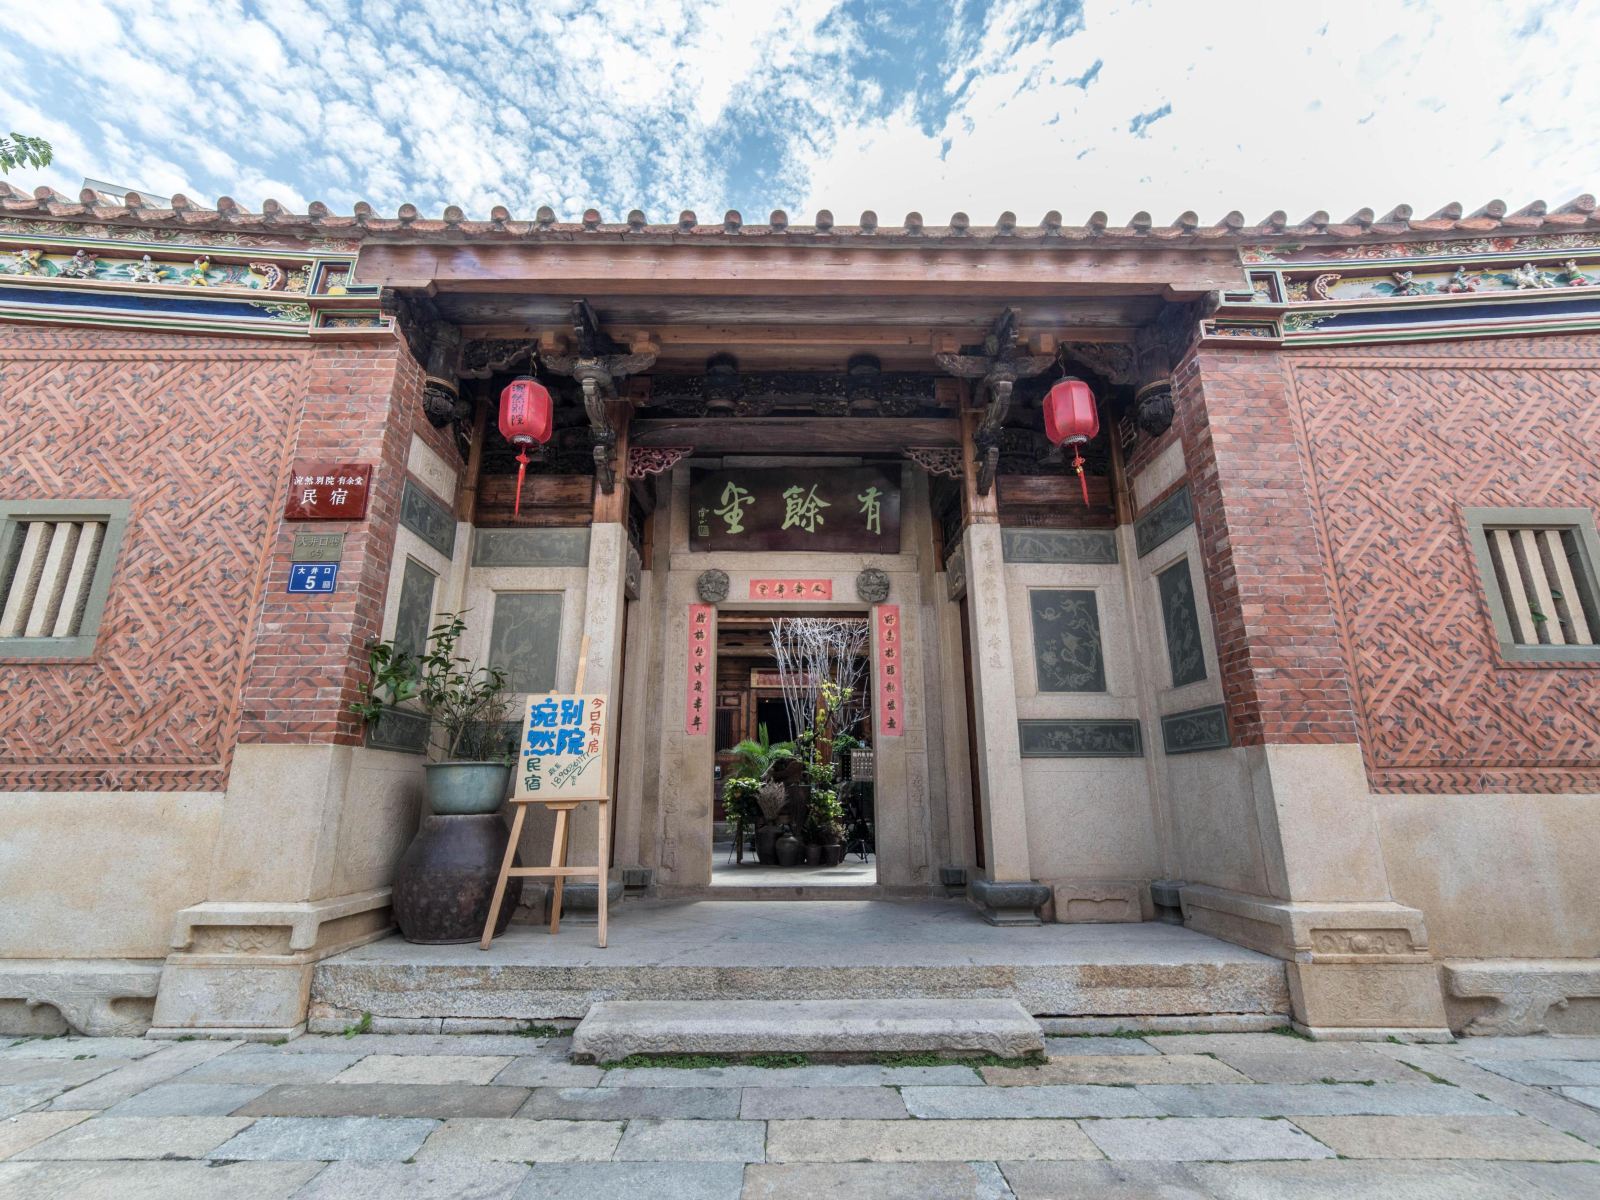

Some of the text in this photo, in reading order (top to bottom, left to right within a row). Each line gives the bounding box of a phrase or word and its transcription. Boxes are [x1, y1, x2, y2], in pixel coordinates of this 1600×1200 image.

[301, 487, 349, 506] 民宿
[297, 567, 331, 575] 大井口
[304, 575, 316, 589] 5
[588, 698, 604, 753] 今日有房
[524, 757, 541, 791] 民宿
